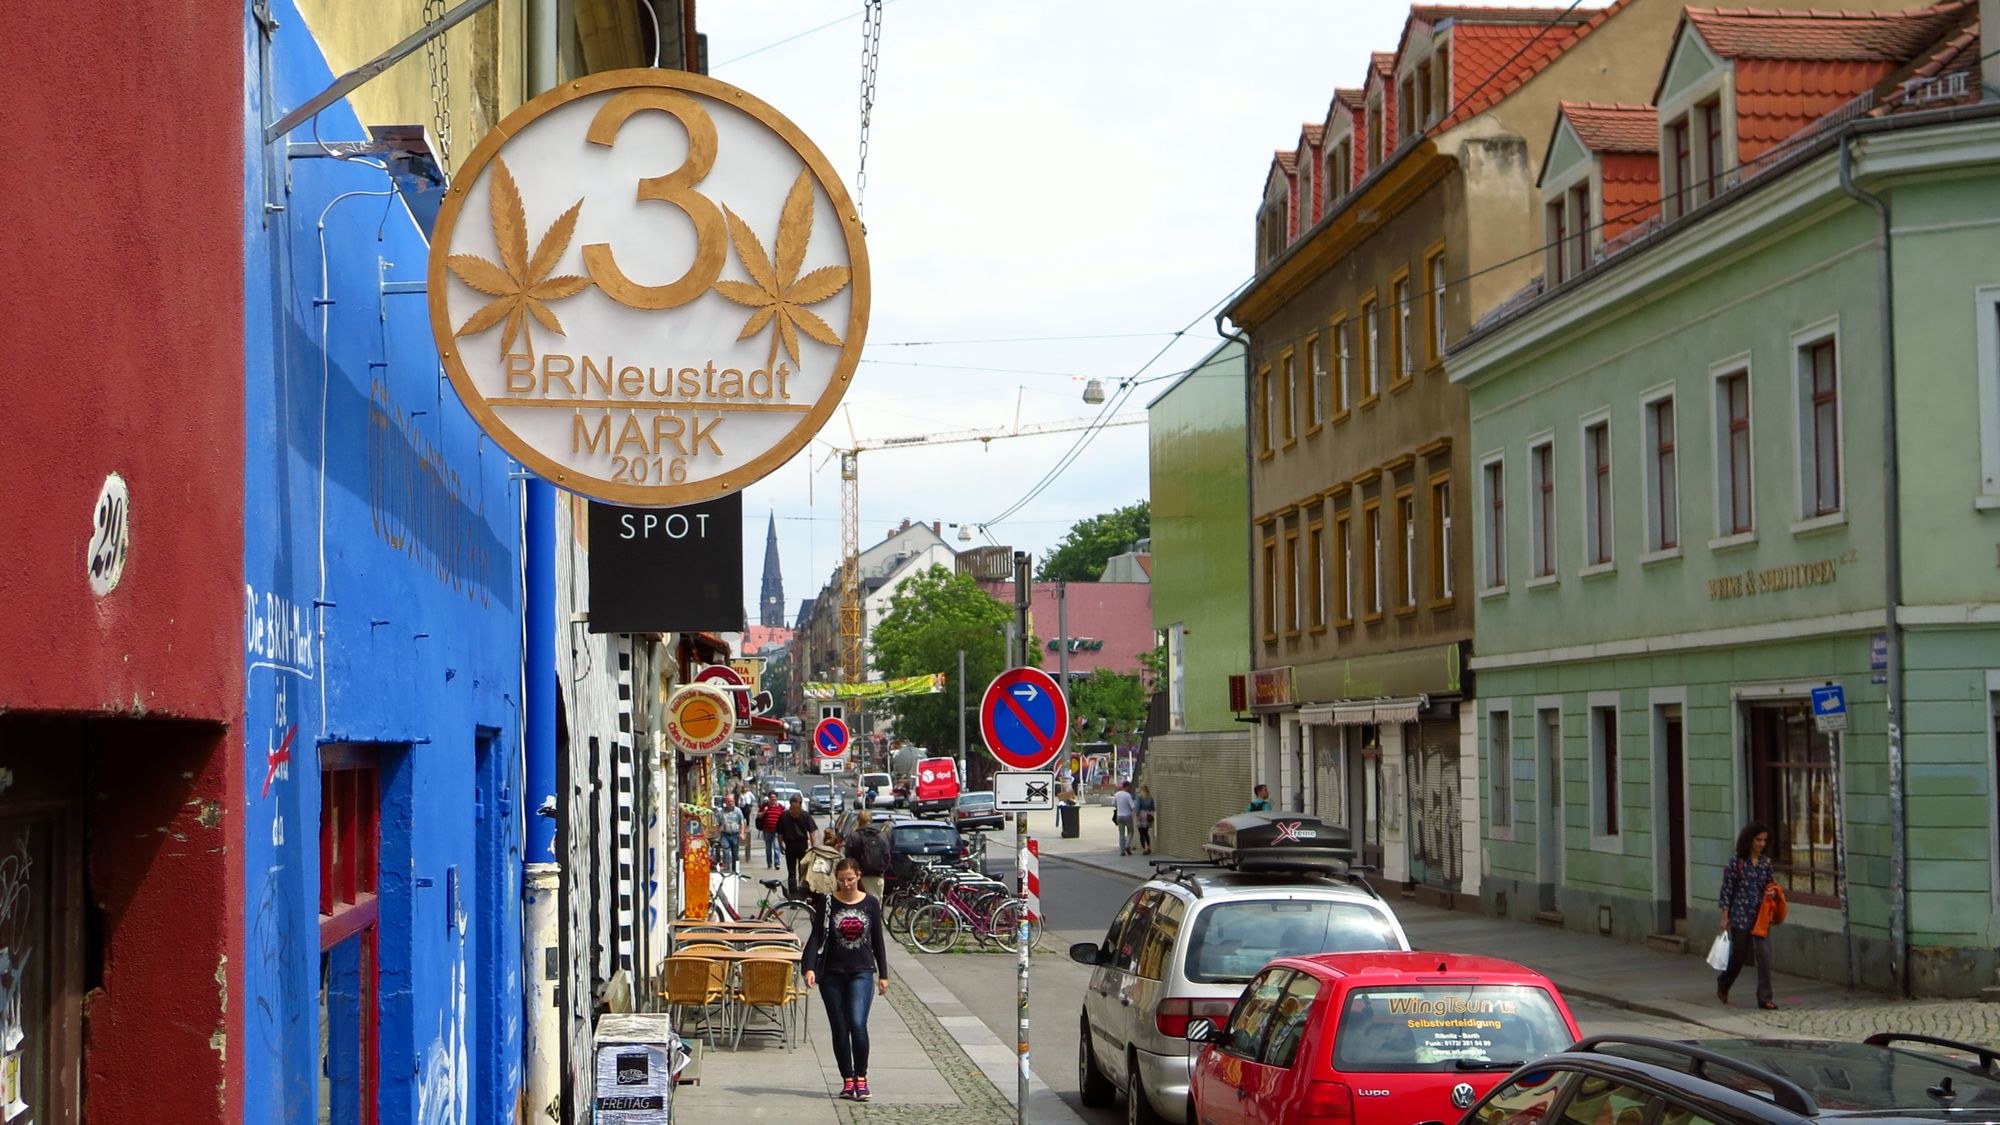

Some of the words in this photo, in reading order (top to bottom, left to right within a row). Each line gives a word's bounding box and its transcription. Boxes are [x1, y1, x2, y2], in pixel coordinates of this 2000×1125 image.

[581, 86, 729, 310] 3
[505, 353, 791, 400] BRNeustadt
[571, 413, 724, 457] MARK
[610, 456, 688, 485] 2016
[90, 493, 122, 581] 29
[619, 513, 710, 539] SPOT
[1744, 569, 1757, 596] &
[247, 583, 264, 655] Die
[275, 675, 287, 727] ist
[682, 738, 698, 750] Thai
[699, 722, 731, 750] Restaurant
[936, 771, 951, 780] dpd
[272, 796, 285, 847] da
[690, 820, 700, 834] P
[1270, 821, 1317, 846] Xtreme
[1389, 995, 1494, 1017] WingTsun
[1407, 1019, 1502, 1029] Selbstverteidigung
[601, 1096, 651, 1109] FREITAG
[1358, 1088, 1390, 1097] Lupo
